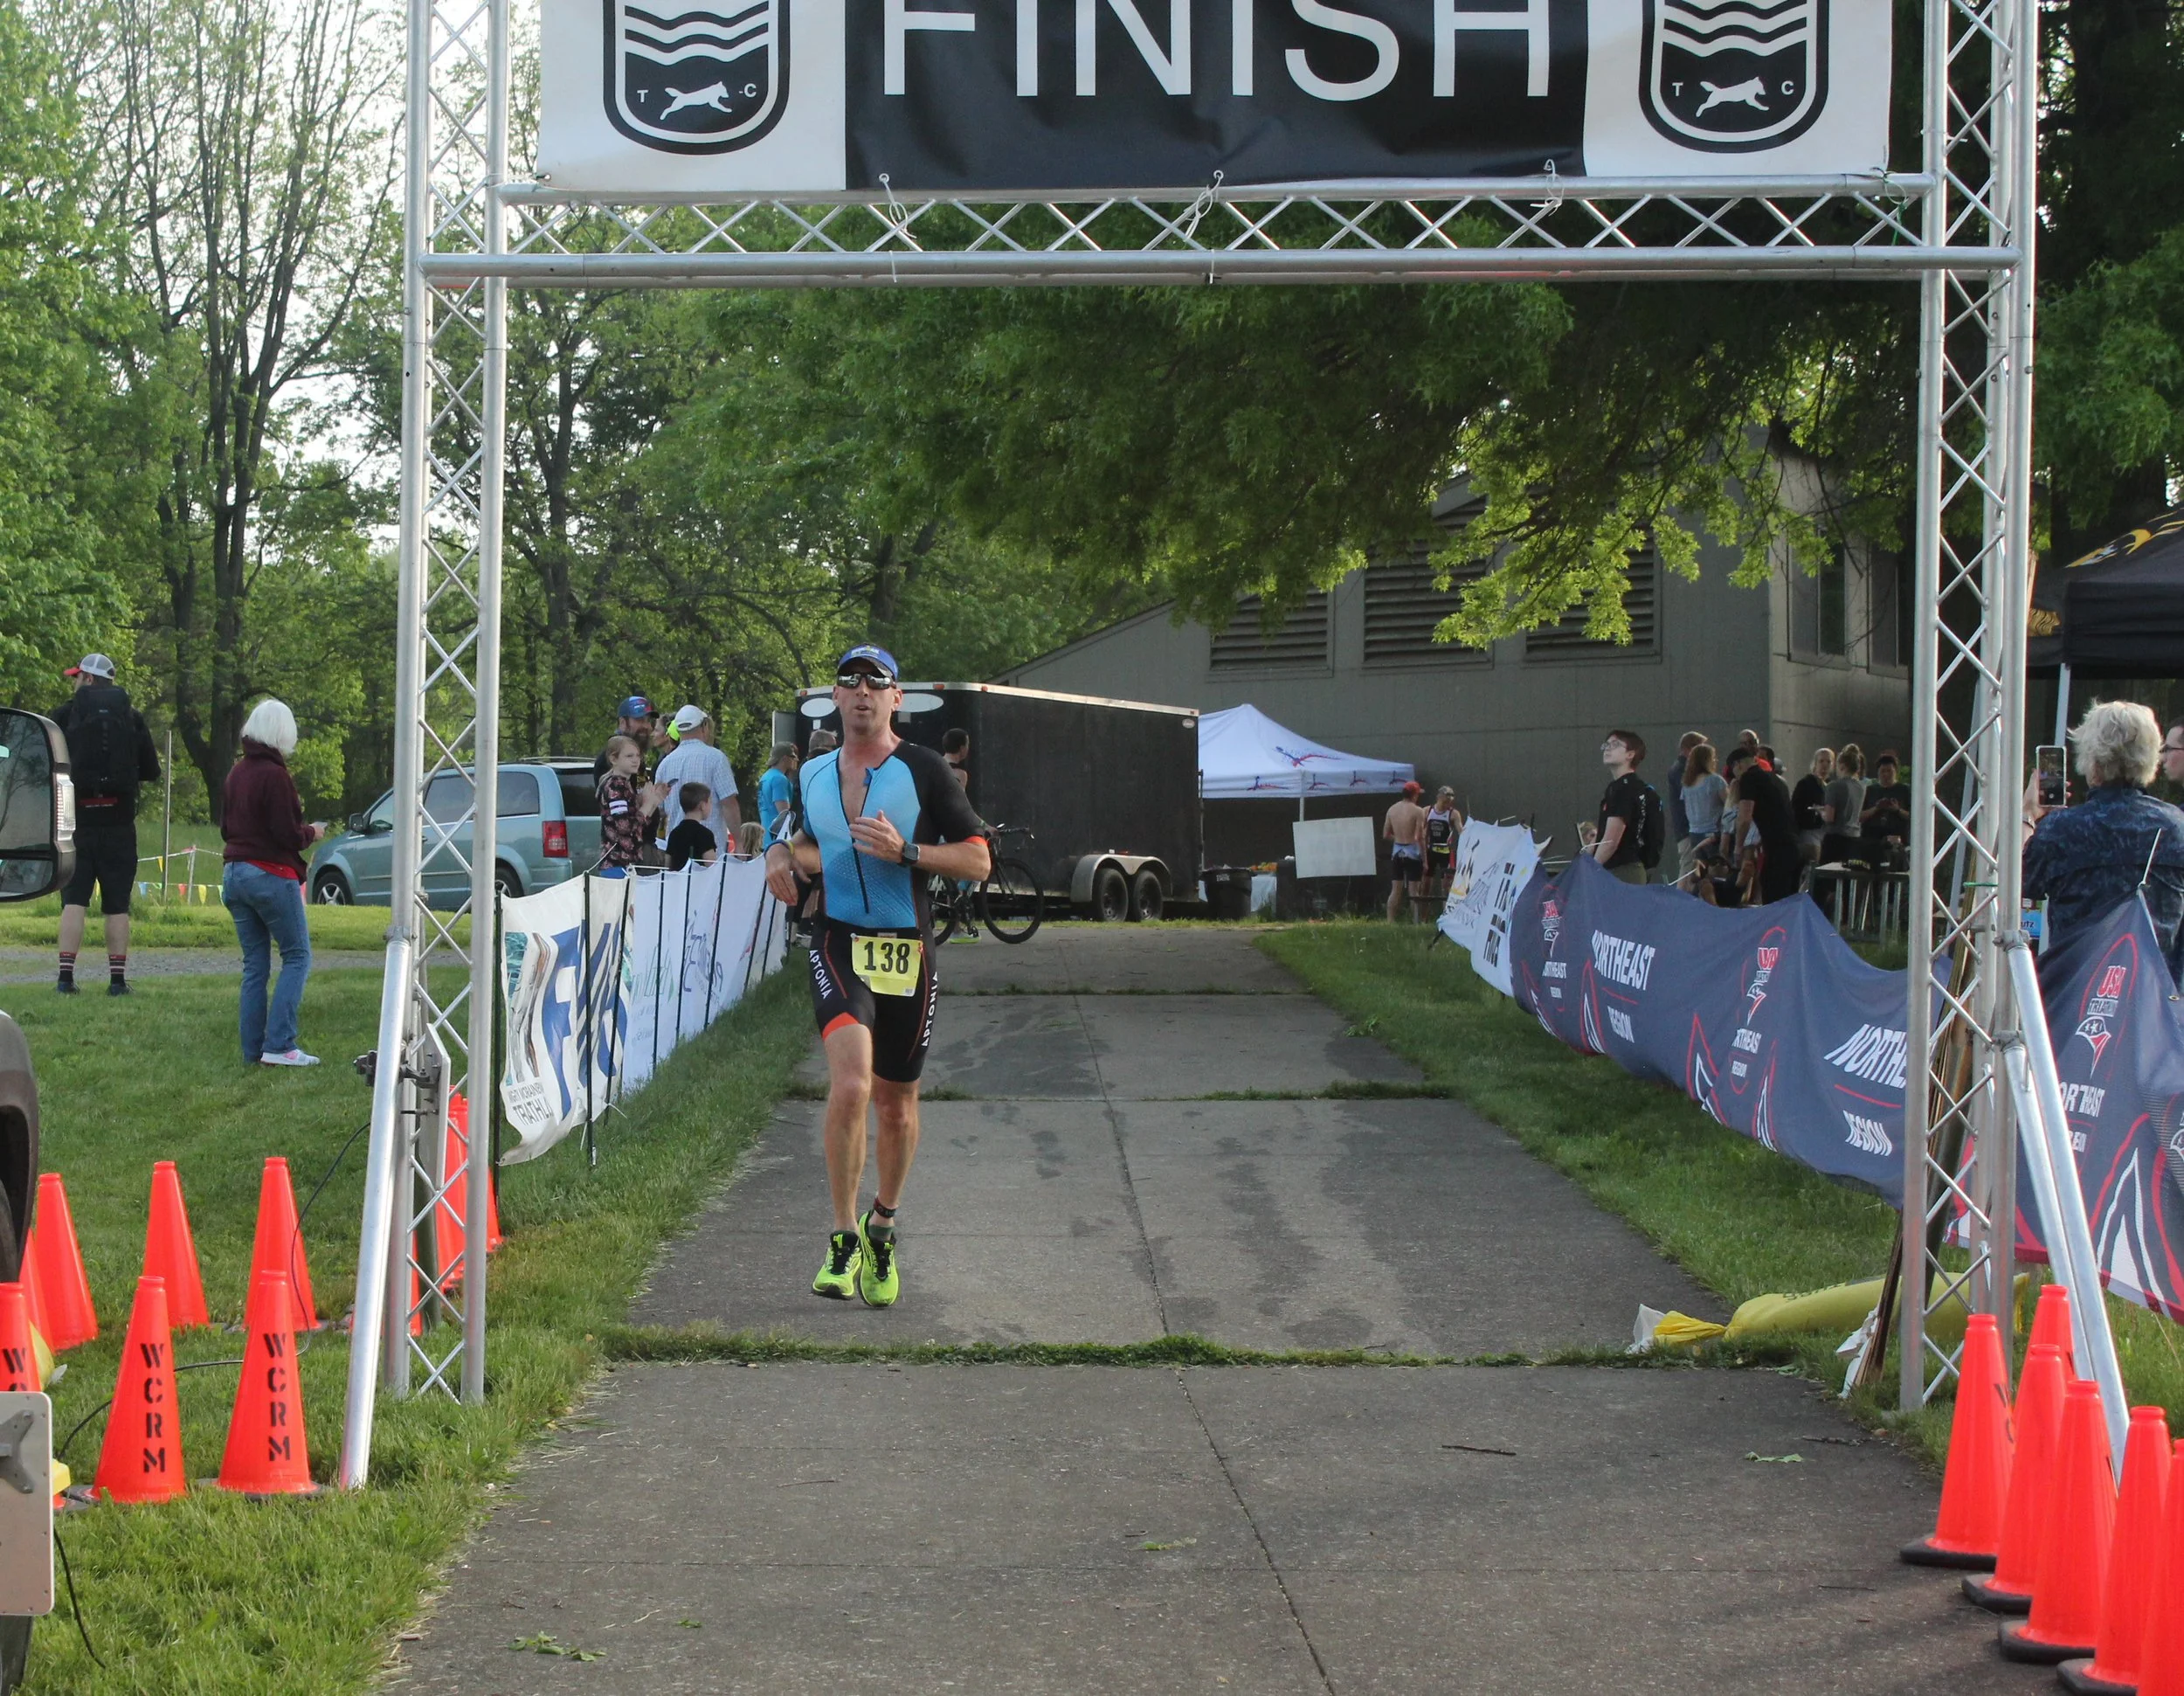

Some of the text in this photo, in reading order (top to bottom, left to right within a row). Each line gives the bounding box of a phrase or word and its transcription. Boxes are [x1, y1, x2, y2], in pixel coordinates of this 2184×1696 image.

[883, 0, 1550, 101] FINISH
[637, 90, 648, 102] T
[1672, 80, 1794, 96] T C
[809, 949, 833, 1000] APTONIA
[863, 941, 910, 974] 138
[921, 972, 938, 1047] APTONIA
[140, 1343, 166, 1473] WCRM
[264, 1333, 291, 1462] WCRM
